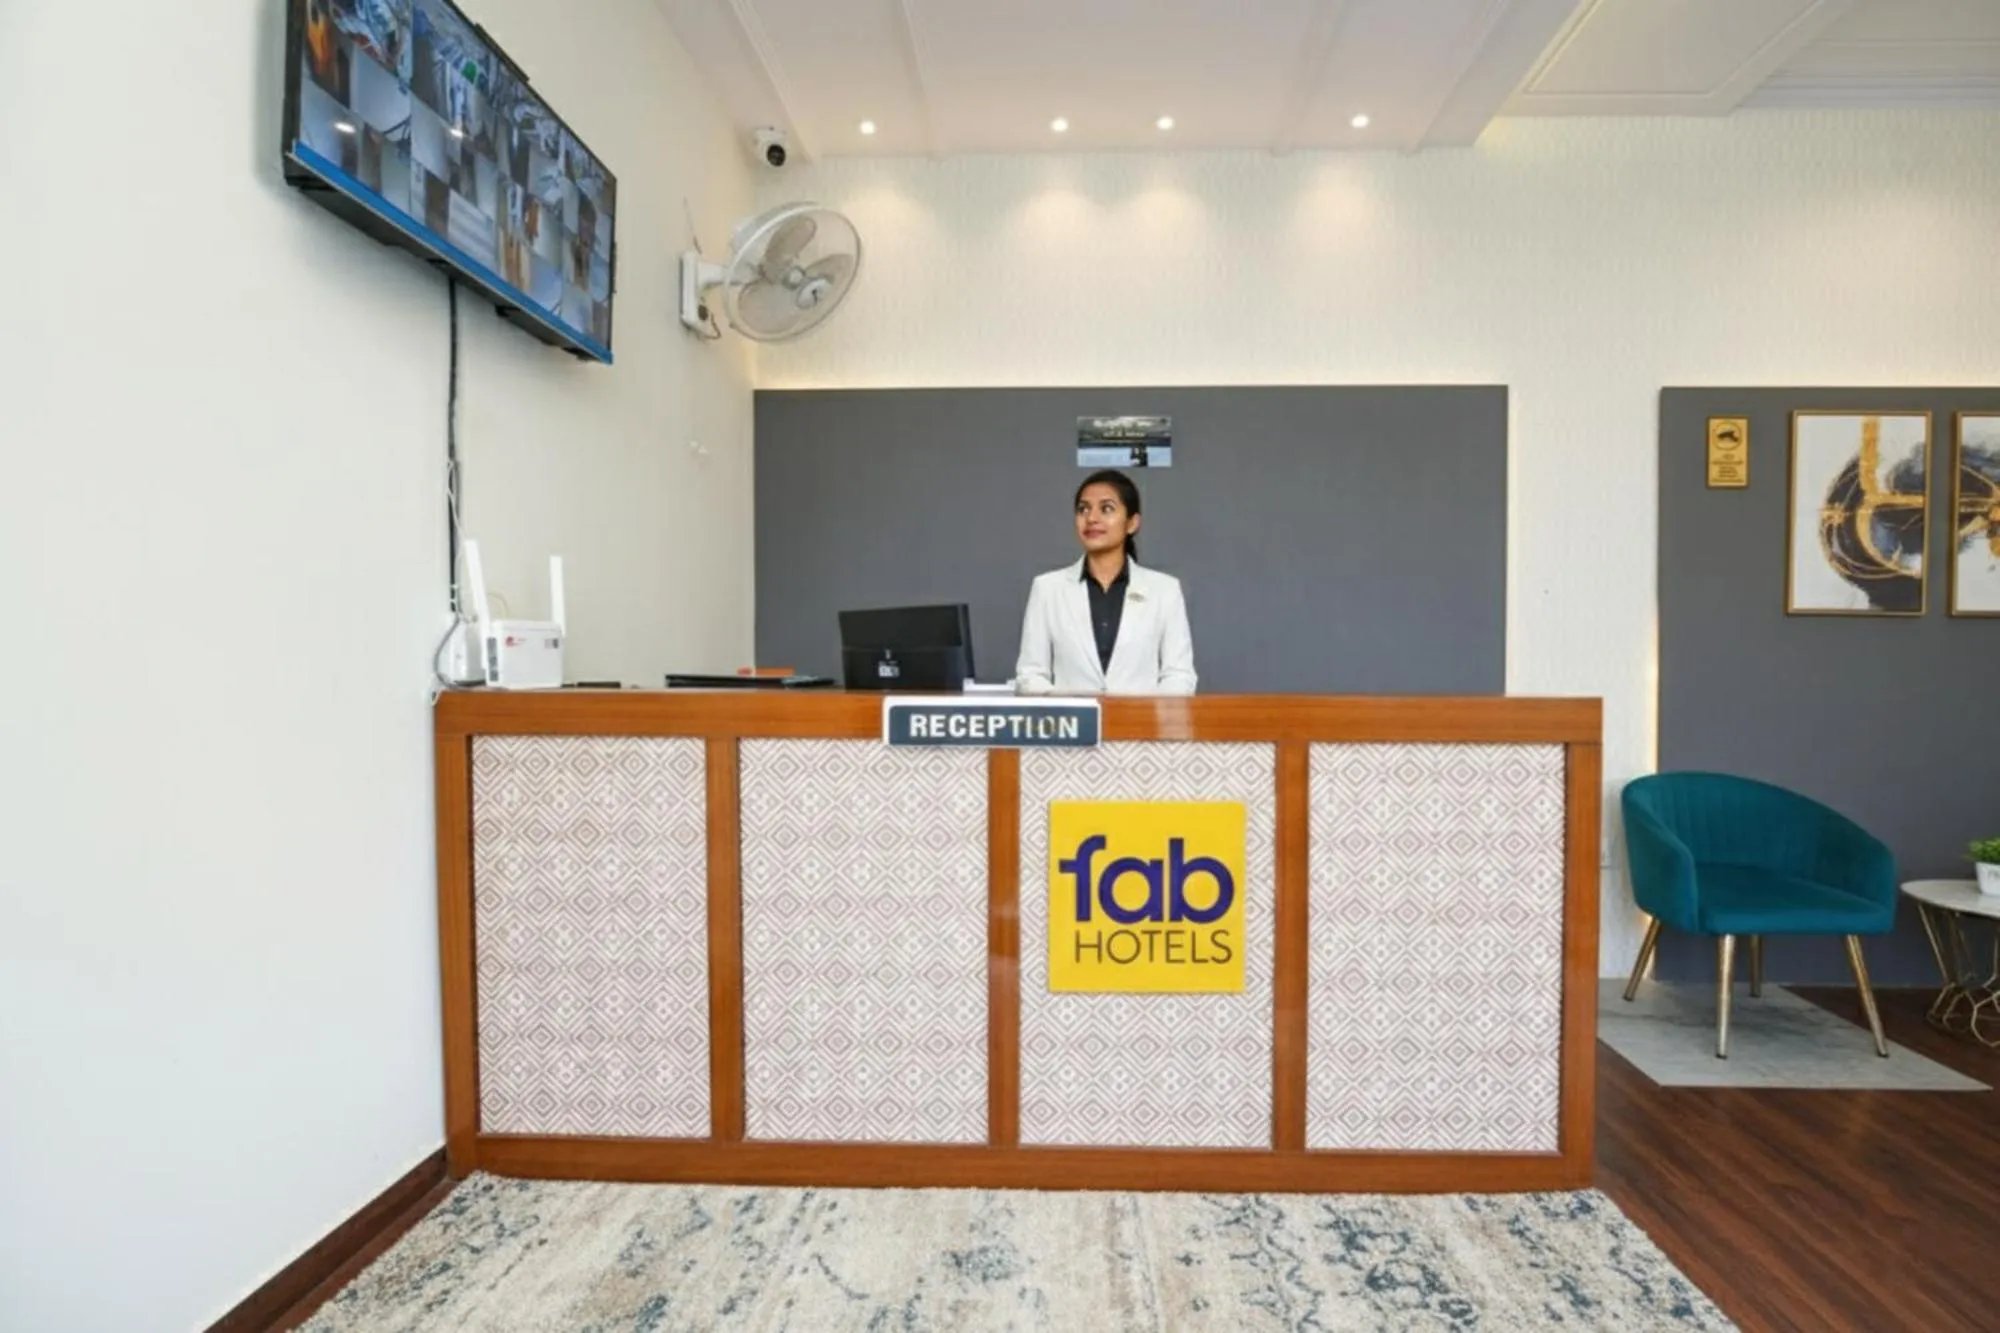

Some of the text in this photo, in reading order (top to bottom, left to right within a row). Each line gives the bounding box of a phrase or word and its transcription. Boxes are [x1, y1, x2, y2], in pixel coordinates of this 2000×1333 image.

[909, 713, 1079, 739] RECEPTION
[1058, 834, 1234, 925] fab
[1074, 929, 1233, 965] HOTELS
